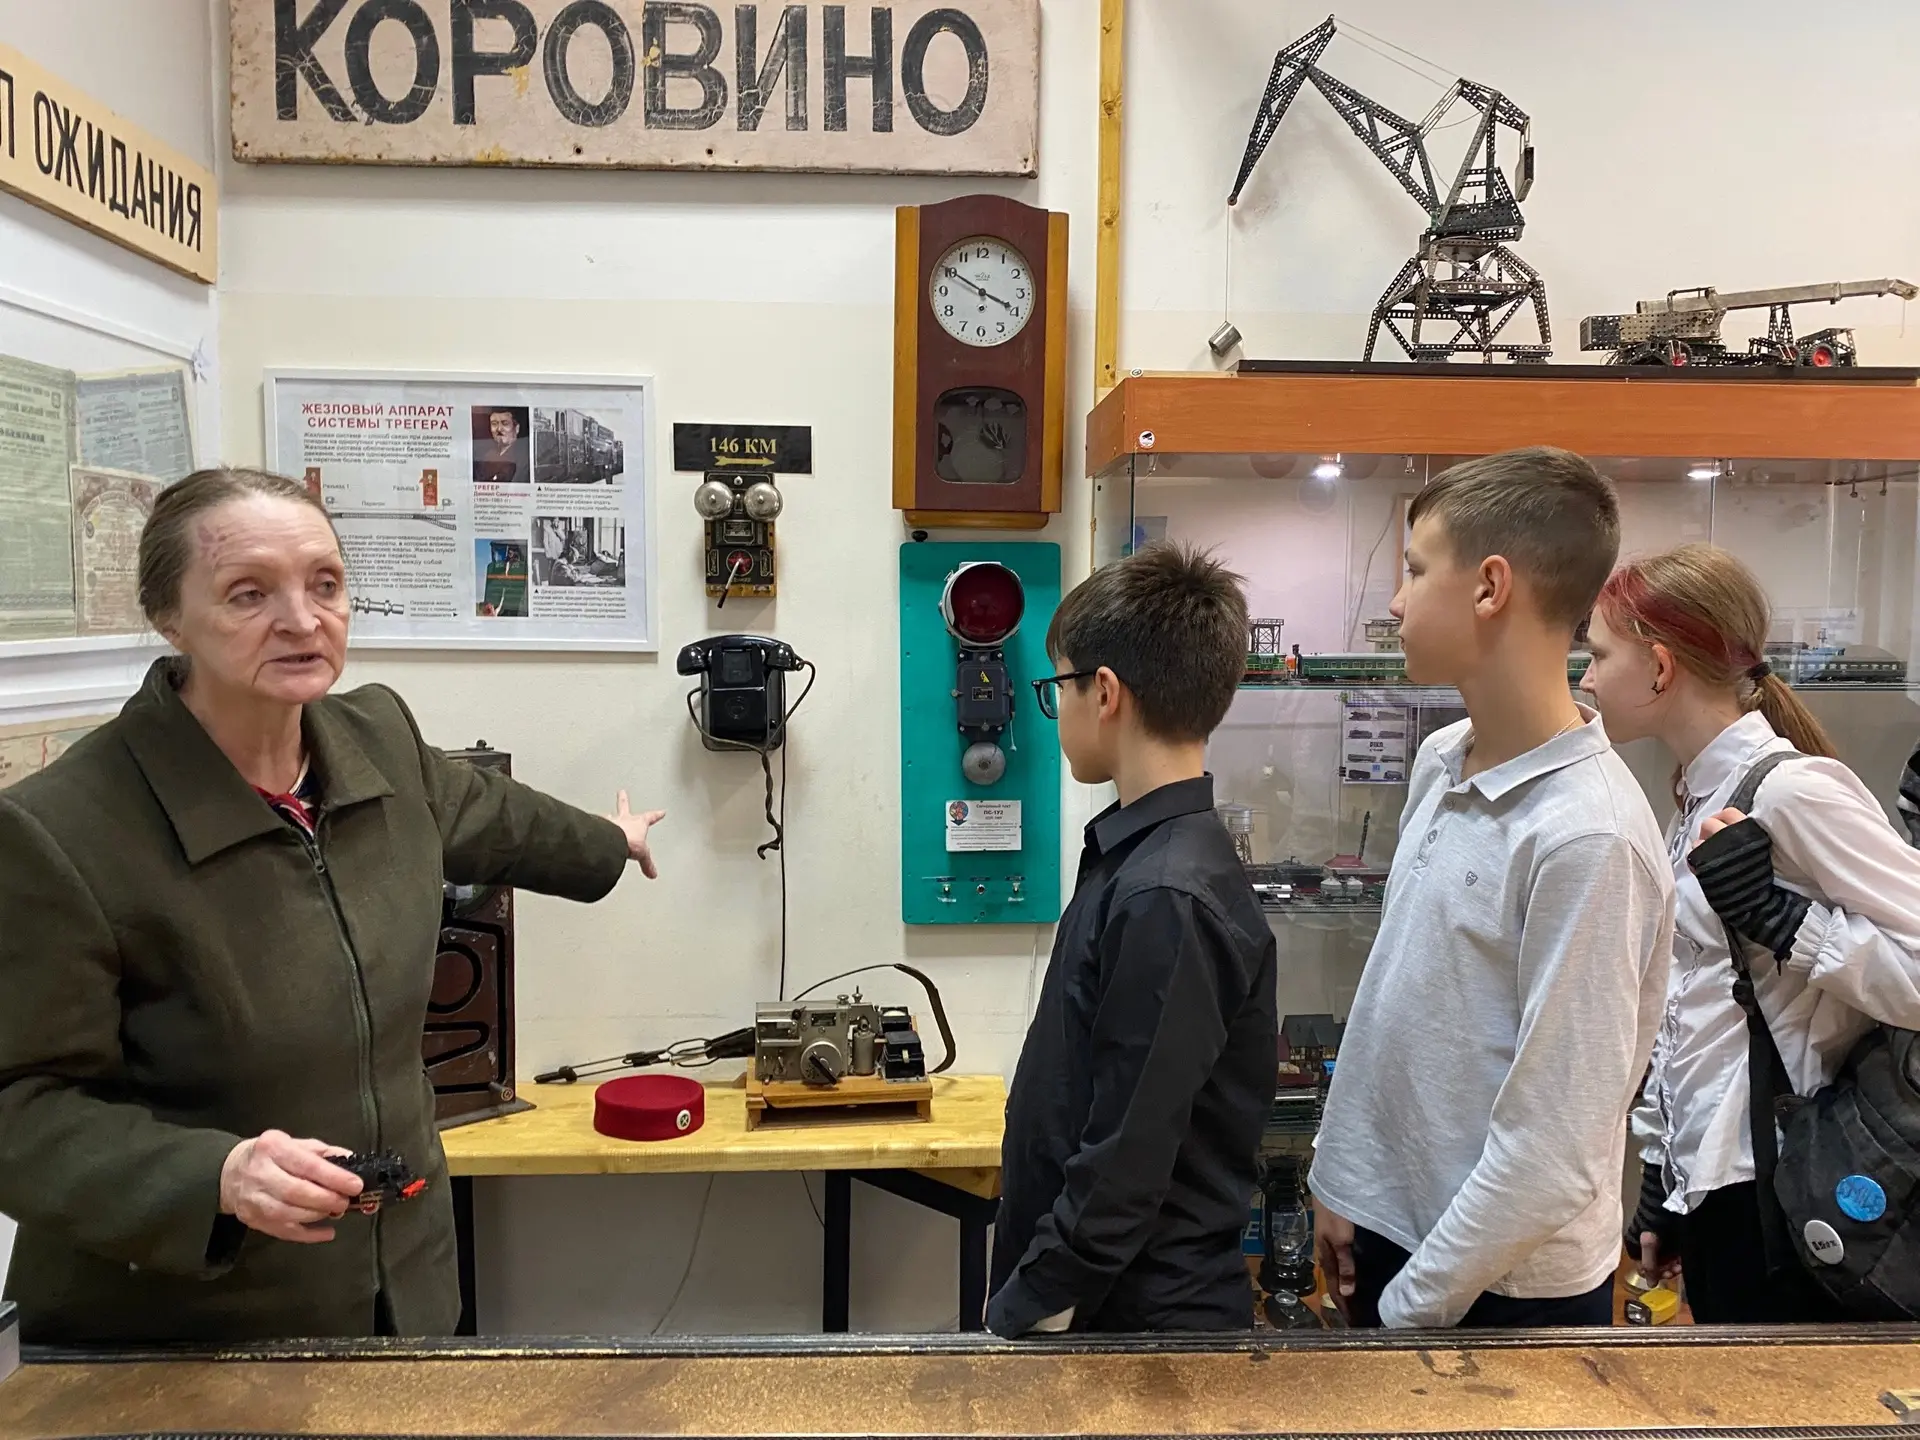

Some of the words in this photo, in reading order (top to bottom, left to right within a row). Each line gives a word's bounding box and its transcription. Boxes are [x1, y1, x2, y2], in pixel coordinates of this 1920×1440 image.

[275, 0, 989, 137] КОРОВИНО
[33, 90, 201, 253] ОЖИДАНИЯ
[959, 251, 968, 263] 11
[976, 247, 989, 259] 12
[1001, 253, 1005, 264] 1
[944, 267, 957, 278] 10
[1010, 268, 1020, 279] 2
[938, 285, 948, 297] 9
[1015, 287, 1025, 299] 3
[944, 304, 953, 317] 8
[1009, 306, 1019, 317] 4
[959, 320, 968, 332] 7
[976, 325, 986, 337] 6
[995, 321, 1005, 333] 5
[302, 402, 384, 416] ЖЕЗЛОВЫЙ
[388, 405, 454, 417] АППАРАТ
[307, 416, 380, 429] СИСТЕМЫ
[385, 418, 449, 430] ТРЕГЕРА
[709, 437, 739, 453] 146
[744, 438, 777, 454] КМ
